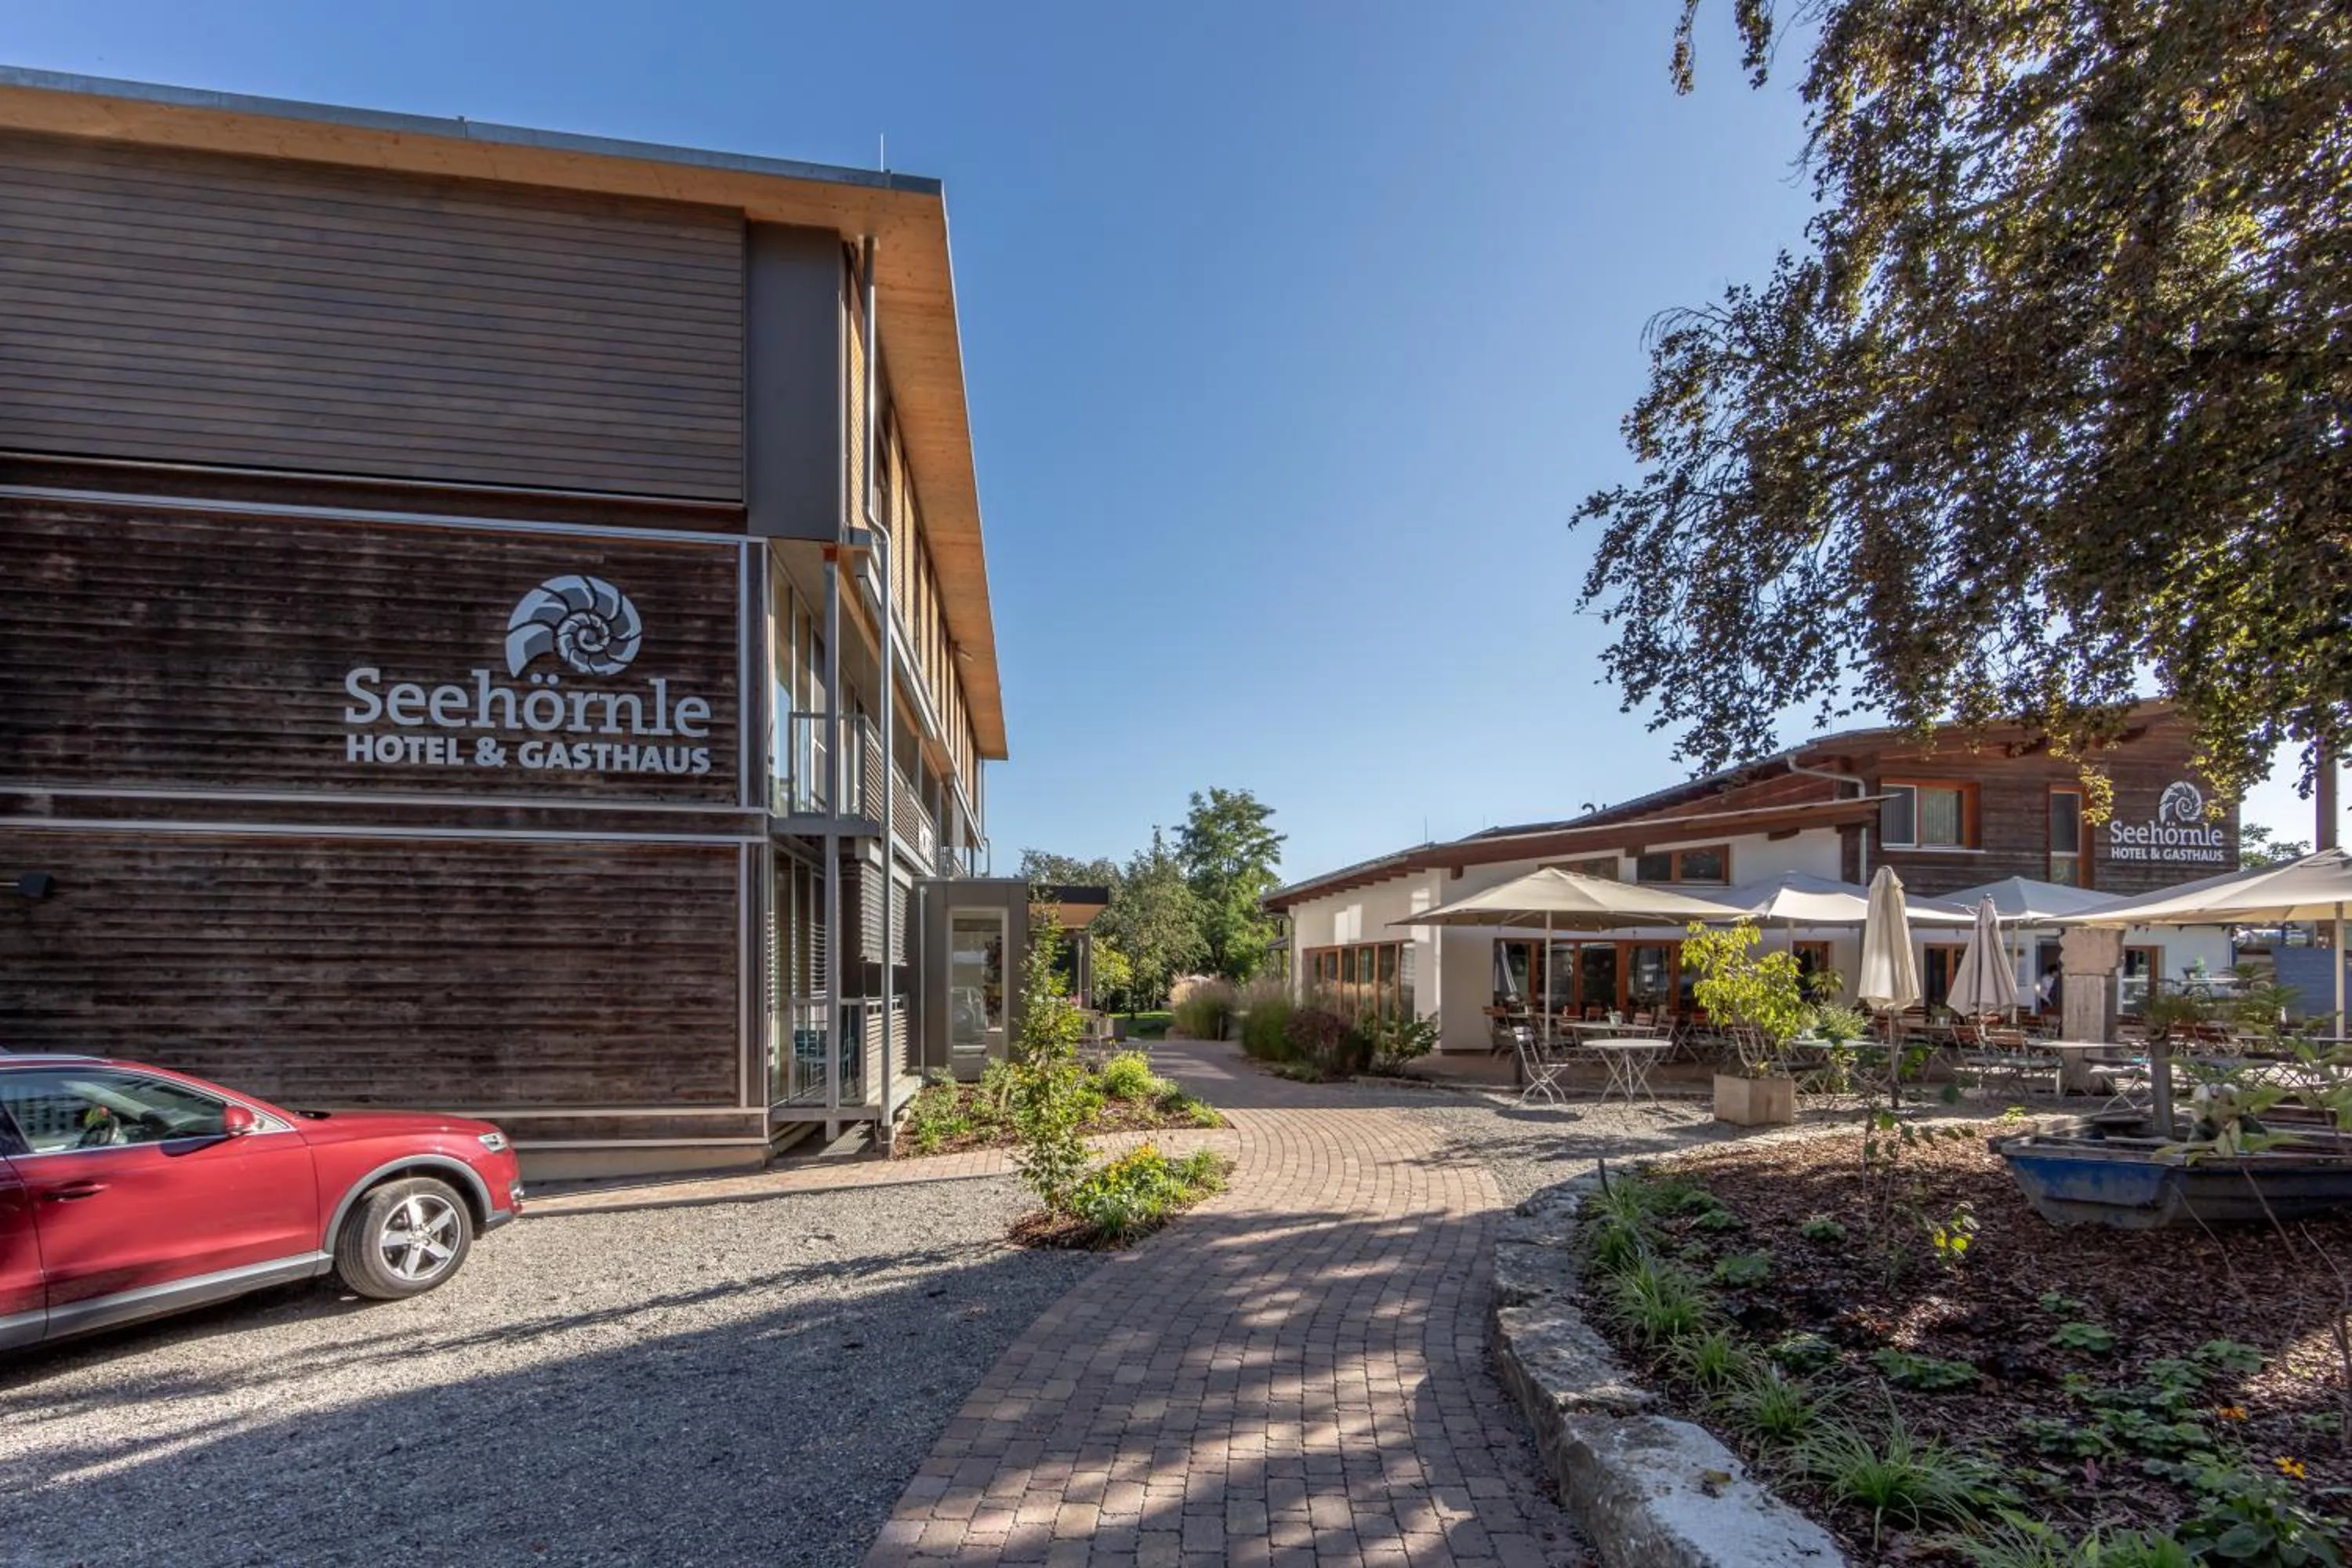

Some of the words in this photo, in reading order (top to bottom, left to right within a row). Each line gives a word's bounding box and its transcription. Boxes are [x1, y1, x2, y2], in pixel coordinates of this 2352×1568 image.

[344, 667, 712, 738] Seehörnle
[347, 735, 465, 766] HOTEL
[474, 736, 506, 769] &
[518, 741, 711, 775] GASTHAUS
[2110, 820, 2223, 847] Seehörnle
[2111, 847, 2147, 860] HOTEL
[2151, 848, 2161, 860] &
[2162, 848, 2224, 862] GASTHAUS
